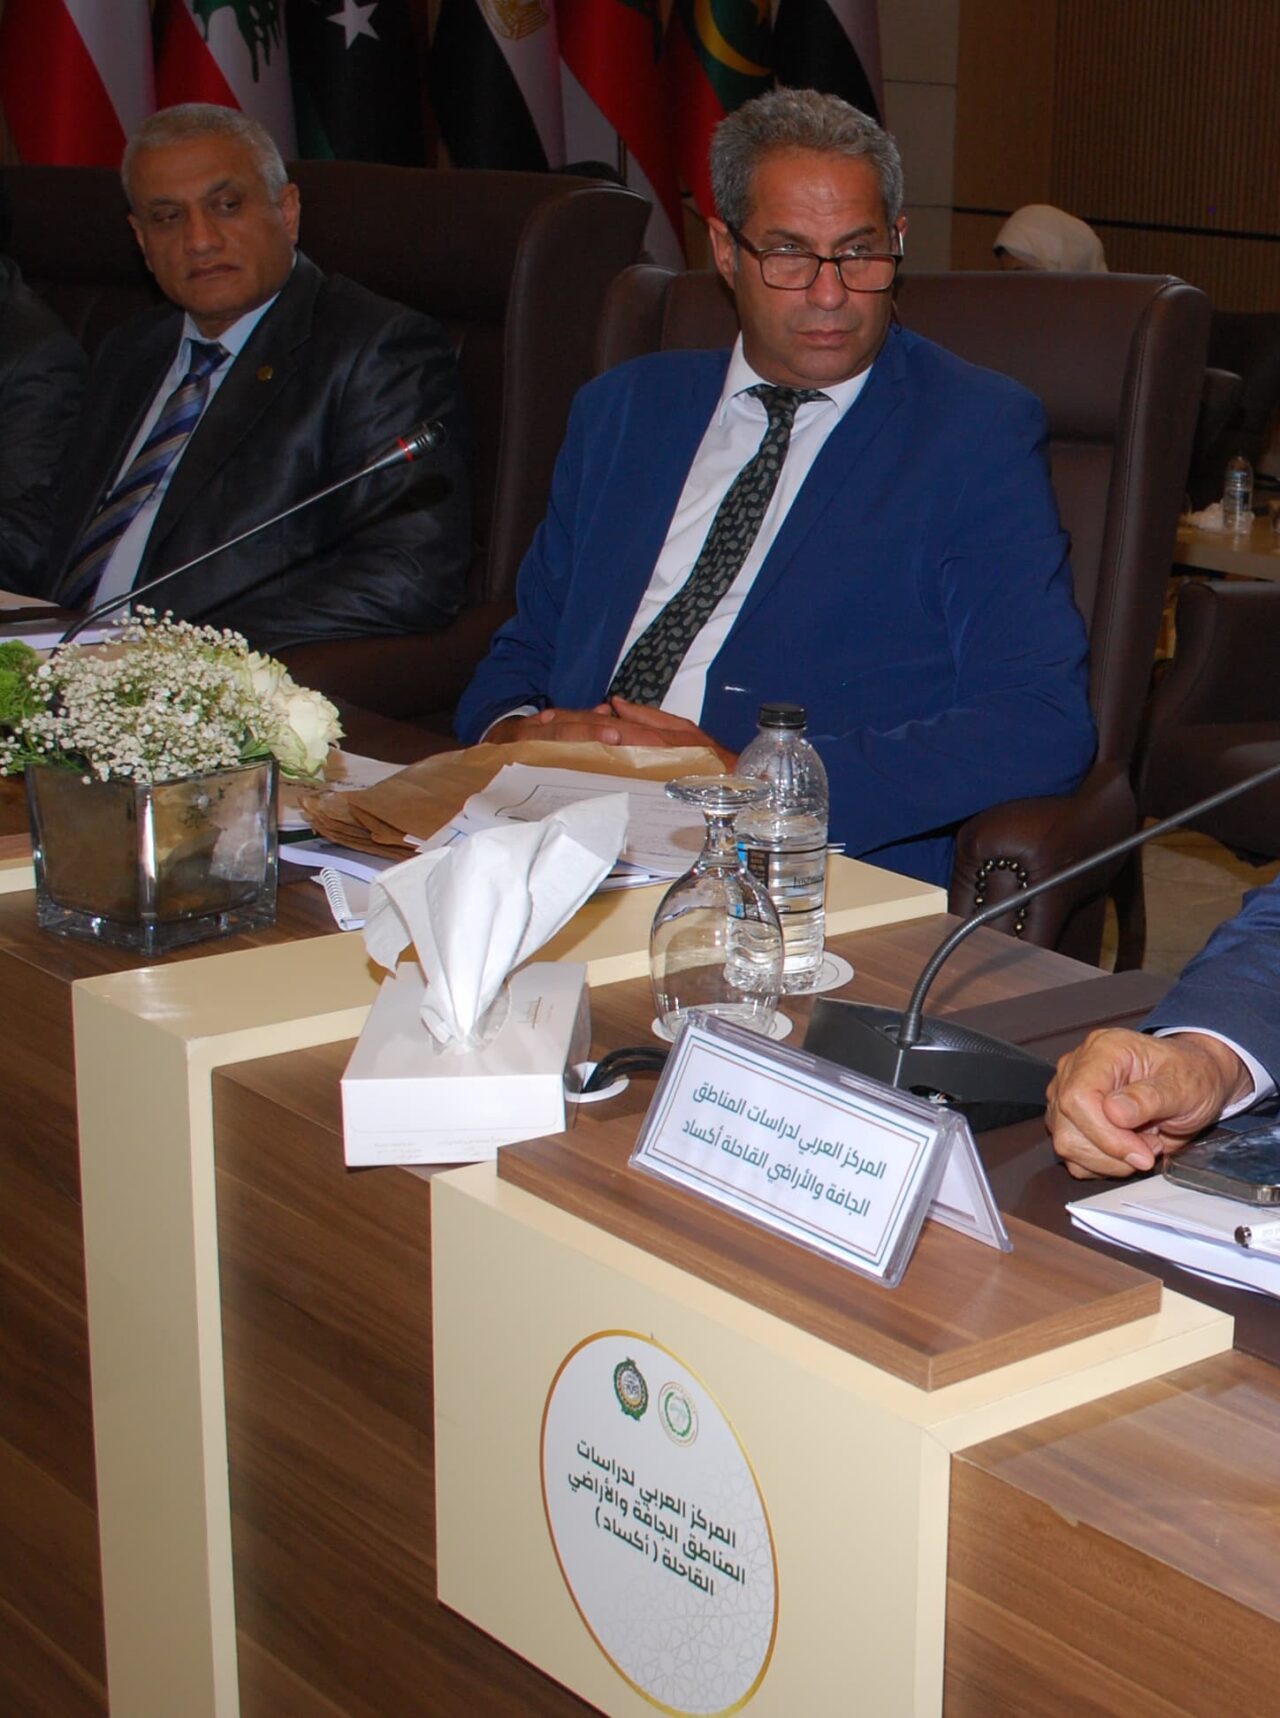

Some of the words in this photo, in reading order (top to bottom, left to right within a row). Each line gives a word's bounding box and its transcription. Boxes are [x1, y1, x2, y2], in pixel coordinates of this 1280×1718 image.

[692, 1081, 747, 1116] المناطق
[682, 1118, 724, 1147] أكساد
[746, 1105, 801, 1140] لدراسات
[721, 1134, 769, 1169] القاحلة
[798, 1136, 844, 1160] العربي
[840, 1146, 887, 1180] المركز
[766, 1163, 824, 1201] والأراضي
[825, 1182, 871, 1218] الجافة
[577, 1439, 635, 1487] لدراسات
[568, 1470, 628, 1517] والأراضي
[639, 1487, 685, 1518] العربي
[633, 1500, 678, 1543] الجافة
[690, 1504, 735, 1548] المركز
[662, 1547, 714, 1597] القاحلة
[682, 1533, 745, 1585] المناطق
